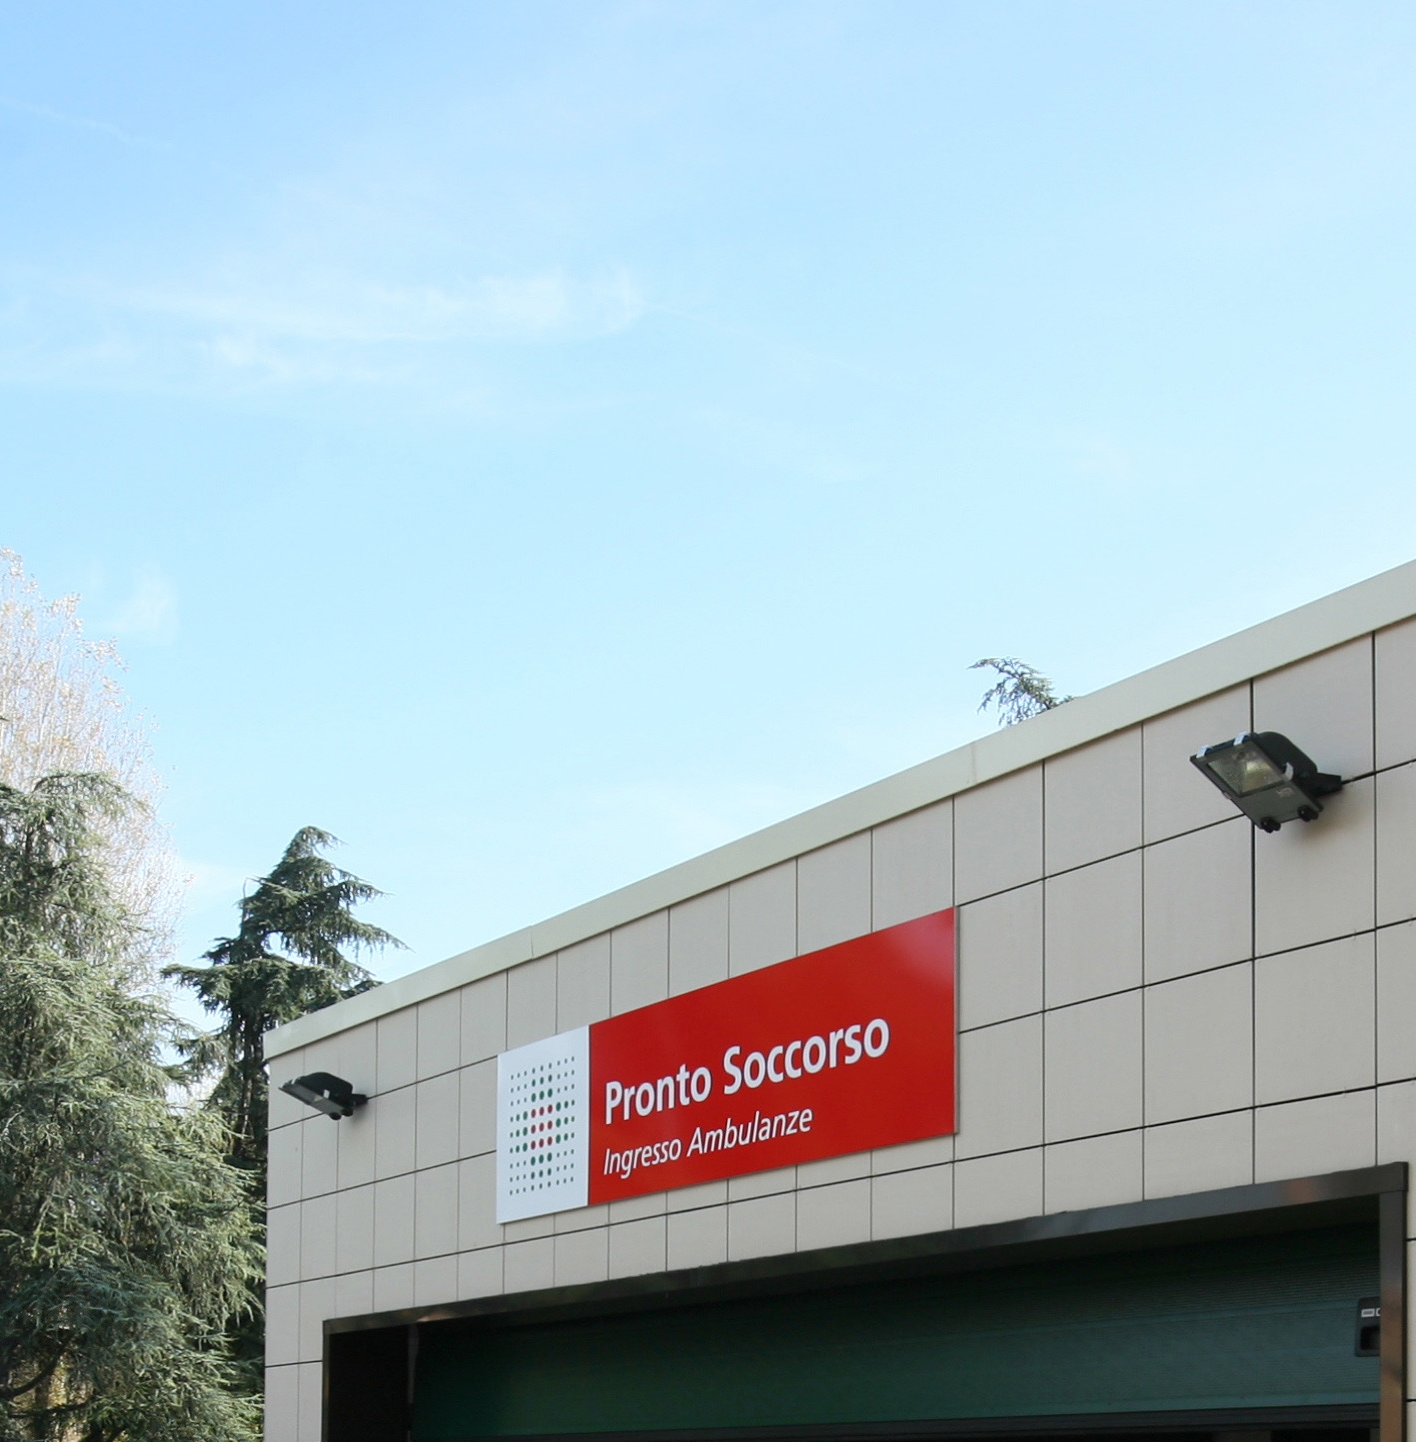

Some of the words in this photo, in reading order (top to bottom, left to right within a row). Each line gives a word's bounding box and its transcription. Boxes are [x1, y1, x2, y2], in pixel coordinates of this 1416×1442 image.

[605, 1063, 712, 1125] Pronto
[723, 1018, 890, 1095] Soccorso
[603, 1138, 682, 1180] Ingresso
[686, 1108, 813, 1157] Ambulanze
